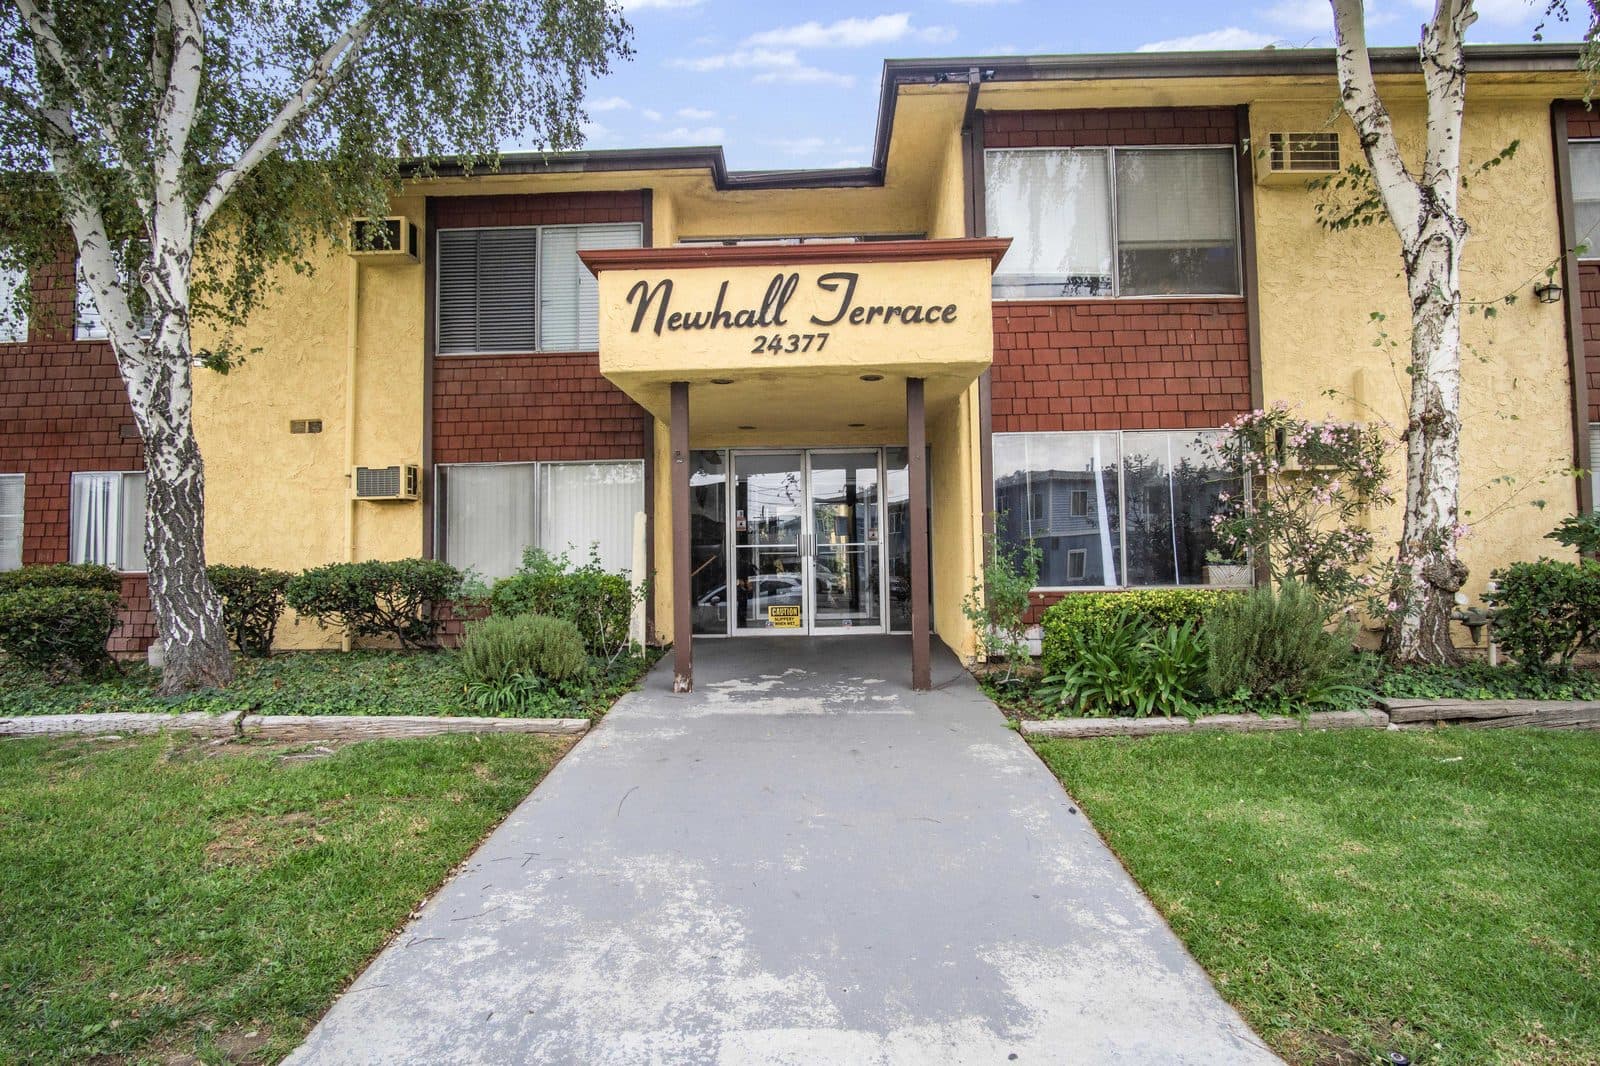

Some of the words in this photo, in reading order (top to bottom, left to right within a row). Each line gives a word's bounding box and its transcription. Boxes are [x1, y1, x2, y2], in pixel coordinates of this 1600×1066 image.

[626, 273, 800, 337] Newhall
[811, 272, 957, 326] Terrace
[751, 333, 830, 355] 24377
[772, 607, 798, 616] CAUTION
